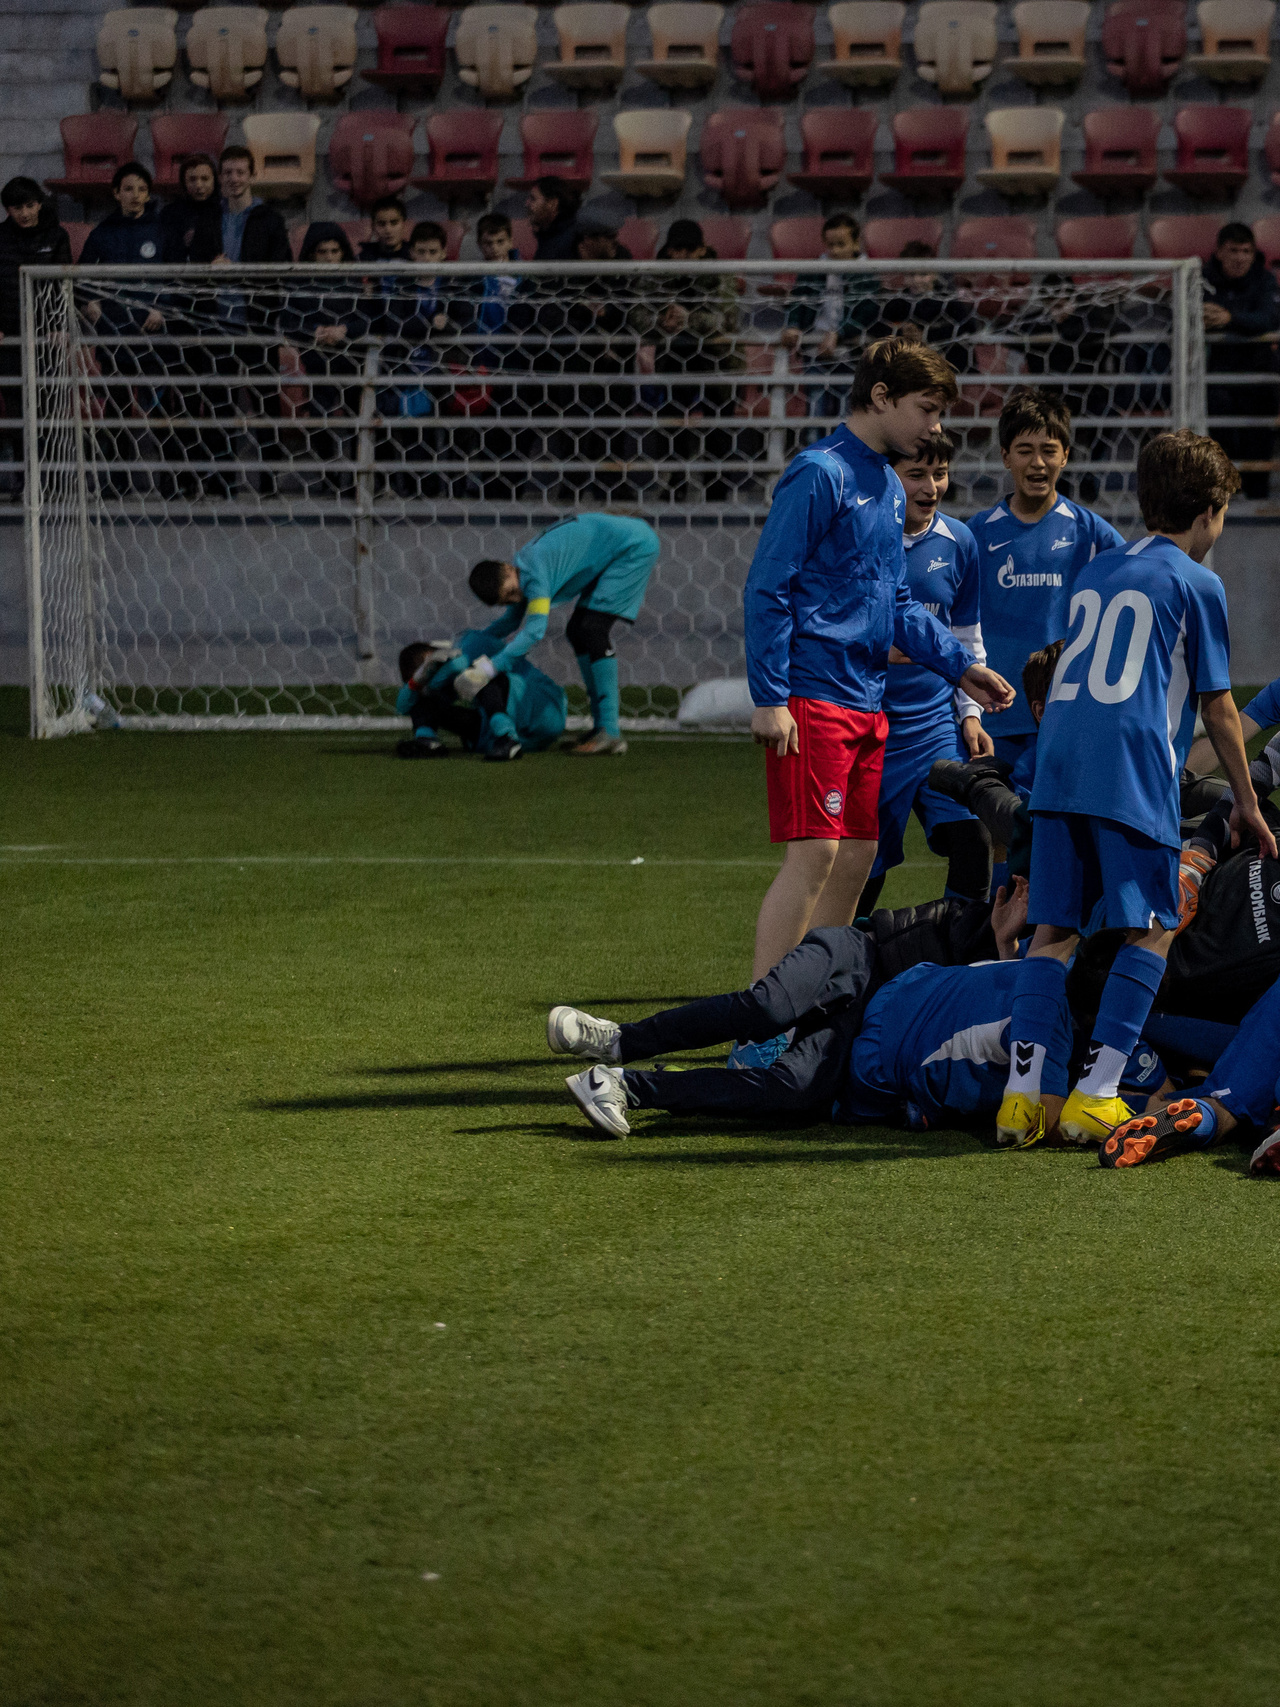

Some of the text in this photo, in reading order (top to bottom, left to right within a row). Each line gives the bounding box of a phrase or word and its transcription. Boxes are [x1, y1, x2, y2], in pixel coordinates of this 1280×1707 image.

[1016, 573, 1062, 587] ГАЗПРОМ
[1048, 589, 1153, 704] 20
[1248, 859, 1271, 944] ГАЗПРОМБАНК
